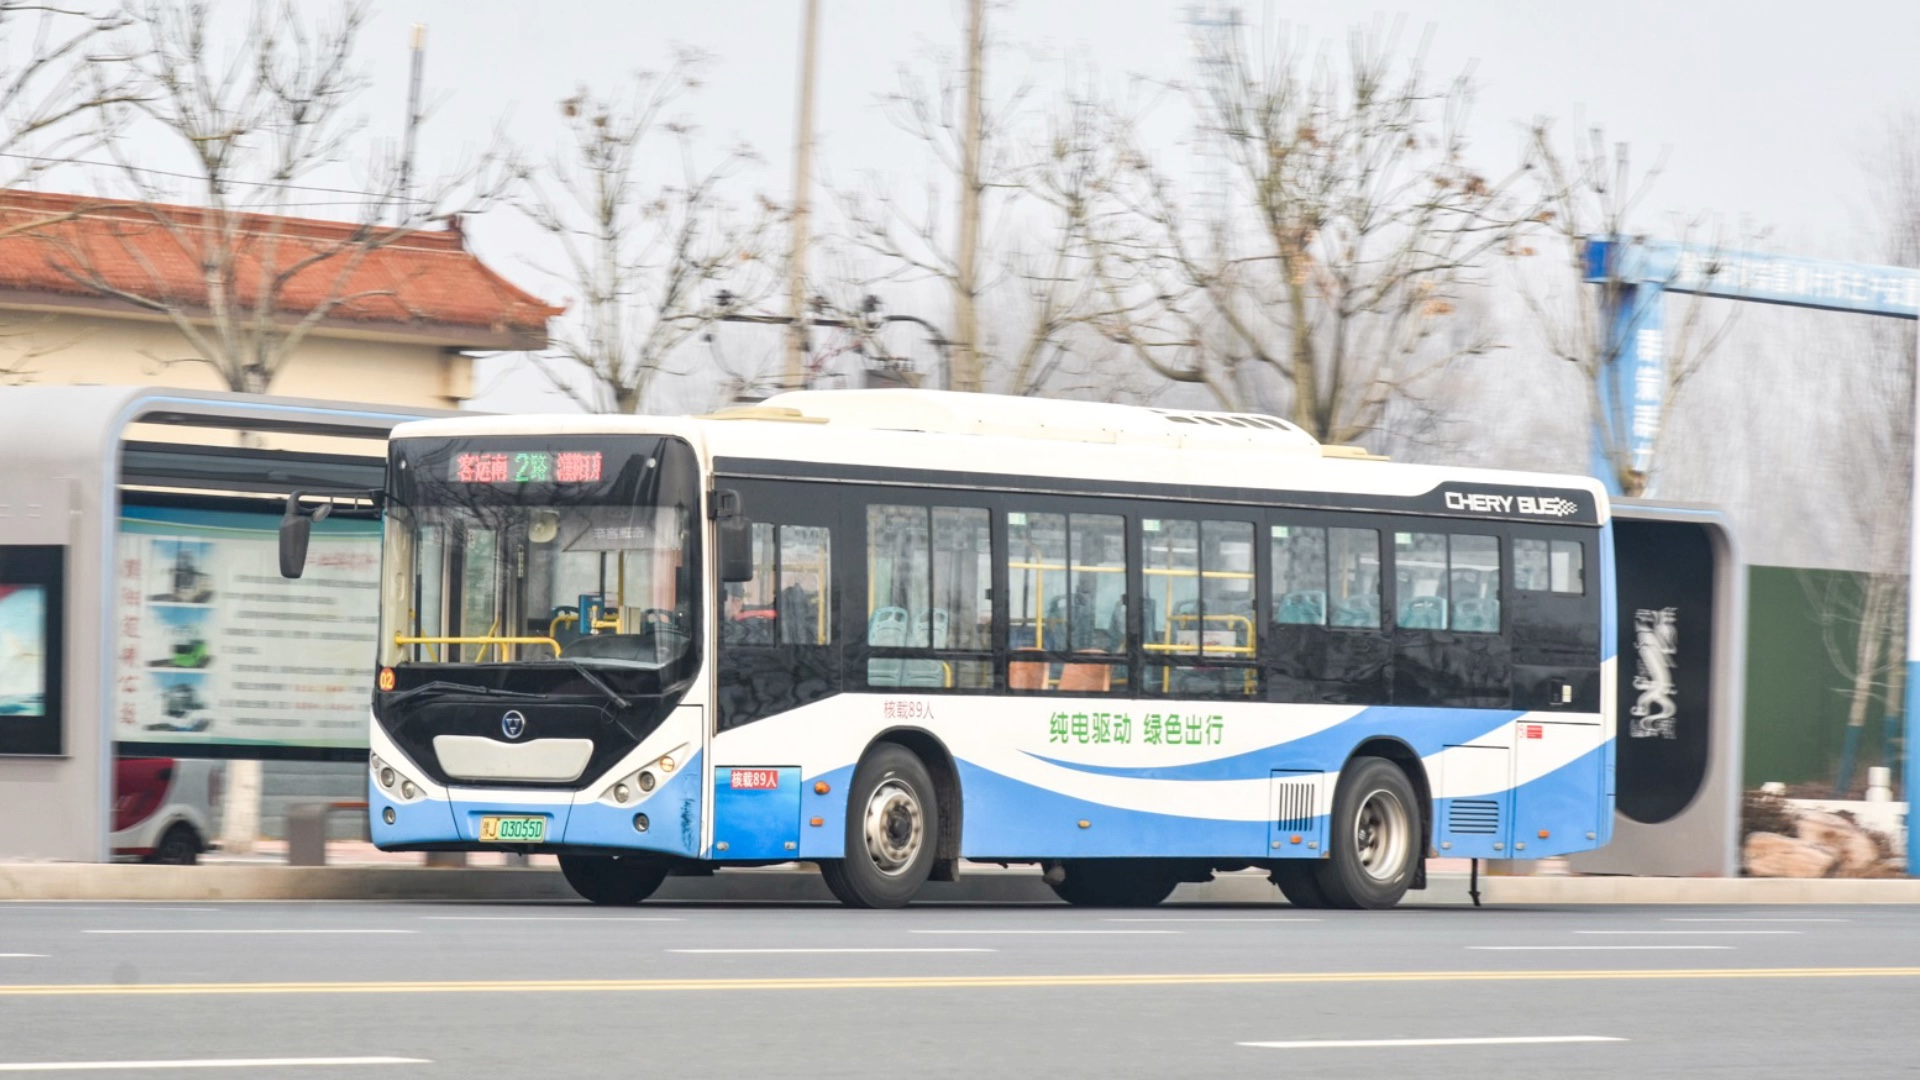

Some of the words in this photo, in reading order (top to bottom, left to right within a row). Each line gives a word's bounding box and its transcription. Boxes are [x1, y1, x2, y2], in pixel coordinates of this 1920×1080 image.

[515, 452, 548, 483] 2路
[1444, 491, 1513, 513] CHERY
[1516, 496, 1561, 515] BUS
[380, 671, 394, 690] 02
[884, 699, 935, 720] 核载89人
[1049, 711, 1132, 744] 纯电驱动
[1143, 713, 1224, 745] 绿色出行
[731, 770, 777, 788] 核载89人
